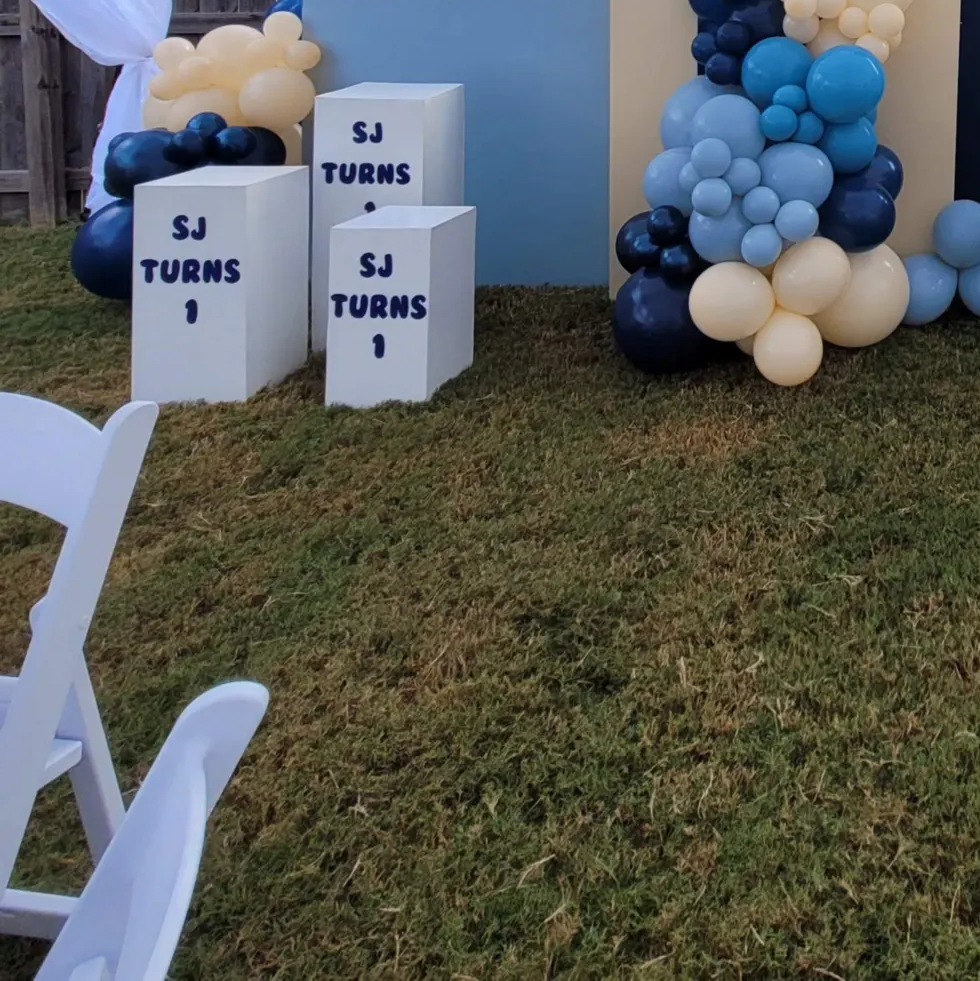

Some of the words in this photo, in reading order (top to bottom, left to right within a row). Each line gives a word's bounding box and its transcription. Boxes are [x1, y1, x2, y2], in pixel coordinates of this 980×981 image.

[352, 121, 383, 144] SJ
[321, 162, 411, 186] TURNS
[172, 214, 207, 241] SJ
[139, 258, 241, 284] TURNS
[359, 252, 393, 279] SJ
[184, 298, 198, 325] 1
[330, 293, 427, 320] TURNS
[372, 333, 386, 359] 1
